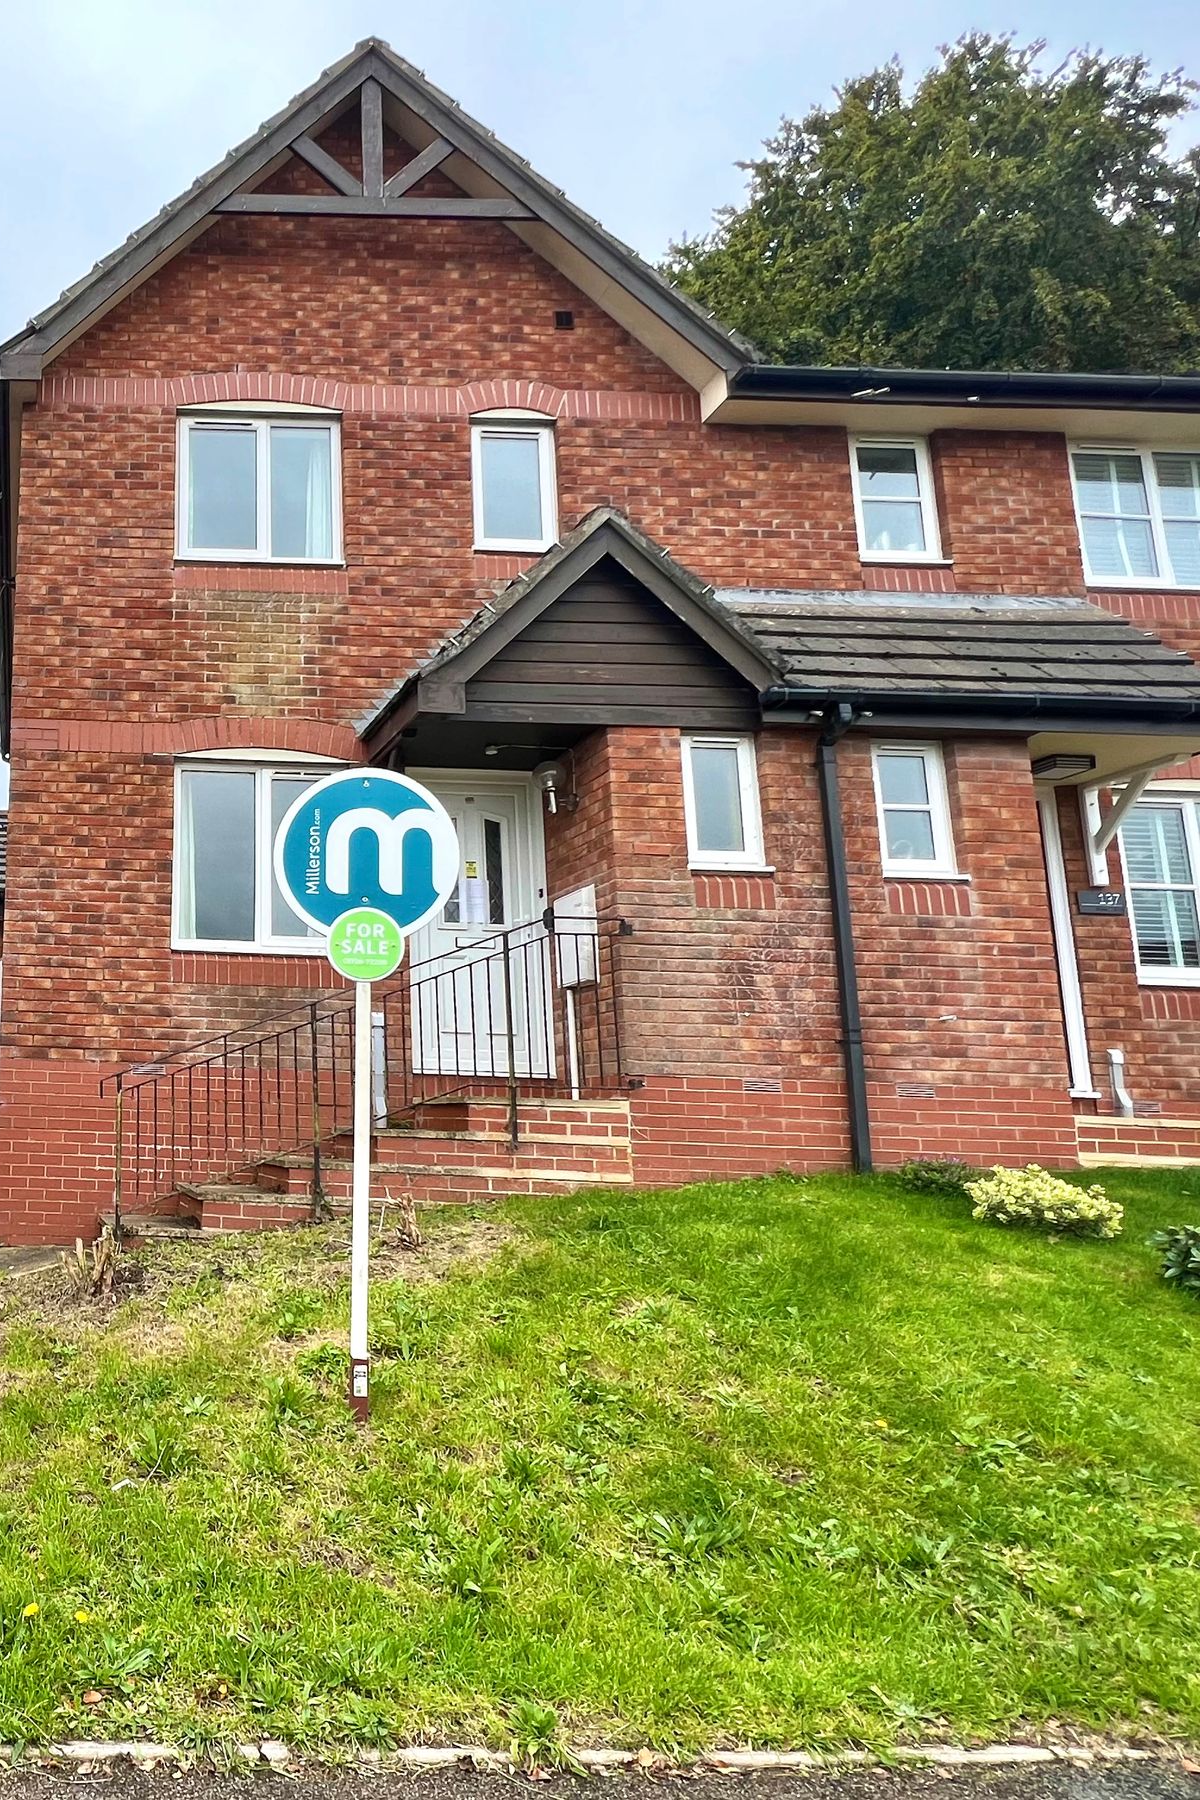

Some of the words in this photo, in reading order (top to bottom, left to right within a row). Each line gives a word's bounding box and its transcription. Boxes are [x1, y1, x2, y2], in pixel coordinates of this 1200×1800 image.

[305, 808, 321, 895] Millerson.com
[346, 922, 385, 938] FOR
[341, 939, 389, 955] SALE
